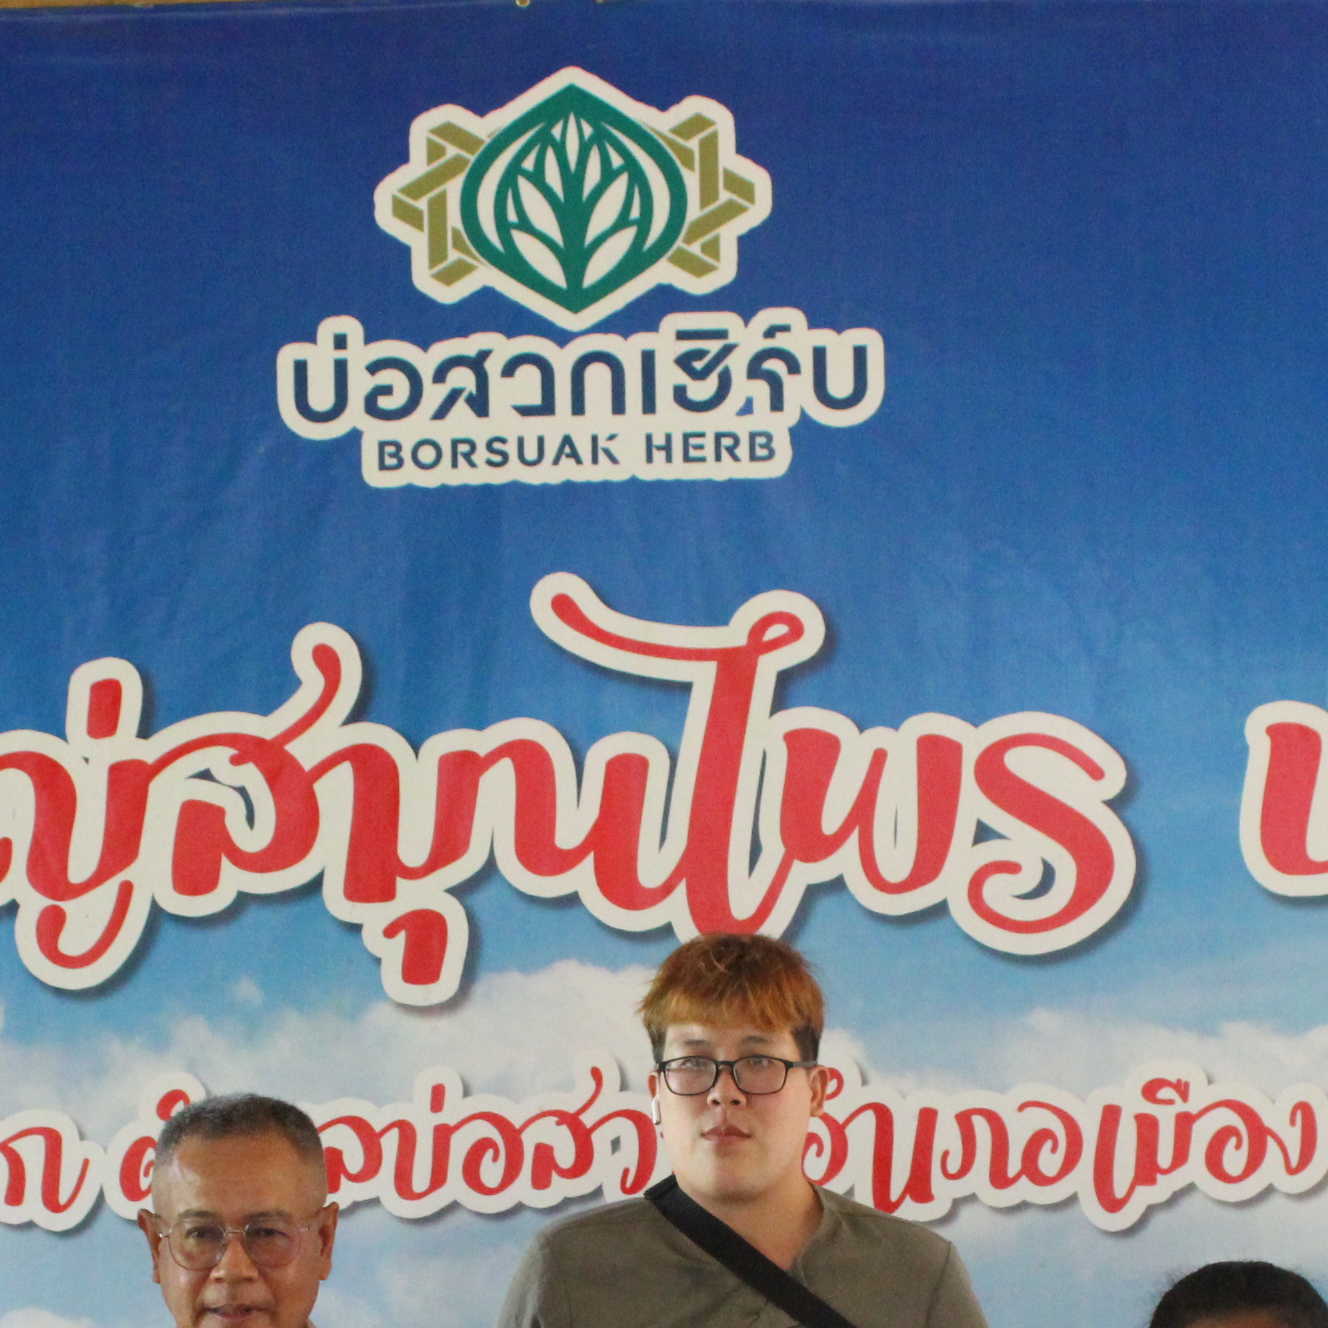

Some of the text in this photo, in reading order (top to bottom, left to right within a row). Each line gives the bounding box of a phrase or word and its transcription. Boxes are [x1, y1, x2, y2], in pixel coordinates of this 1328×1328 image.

[293, 323, 868, 424] บ่อสวกเฮิร์บ
[377, 430, 776, 471] BORSUAK HERB
